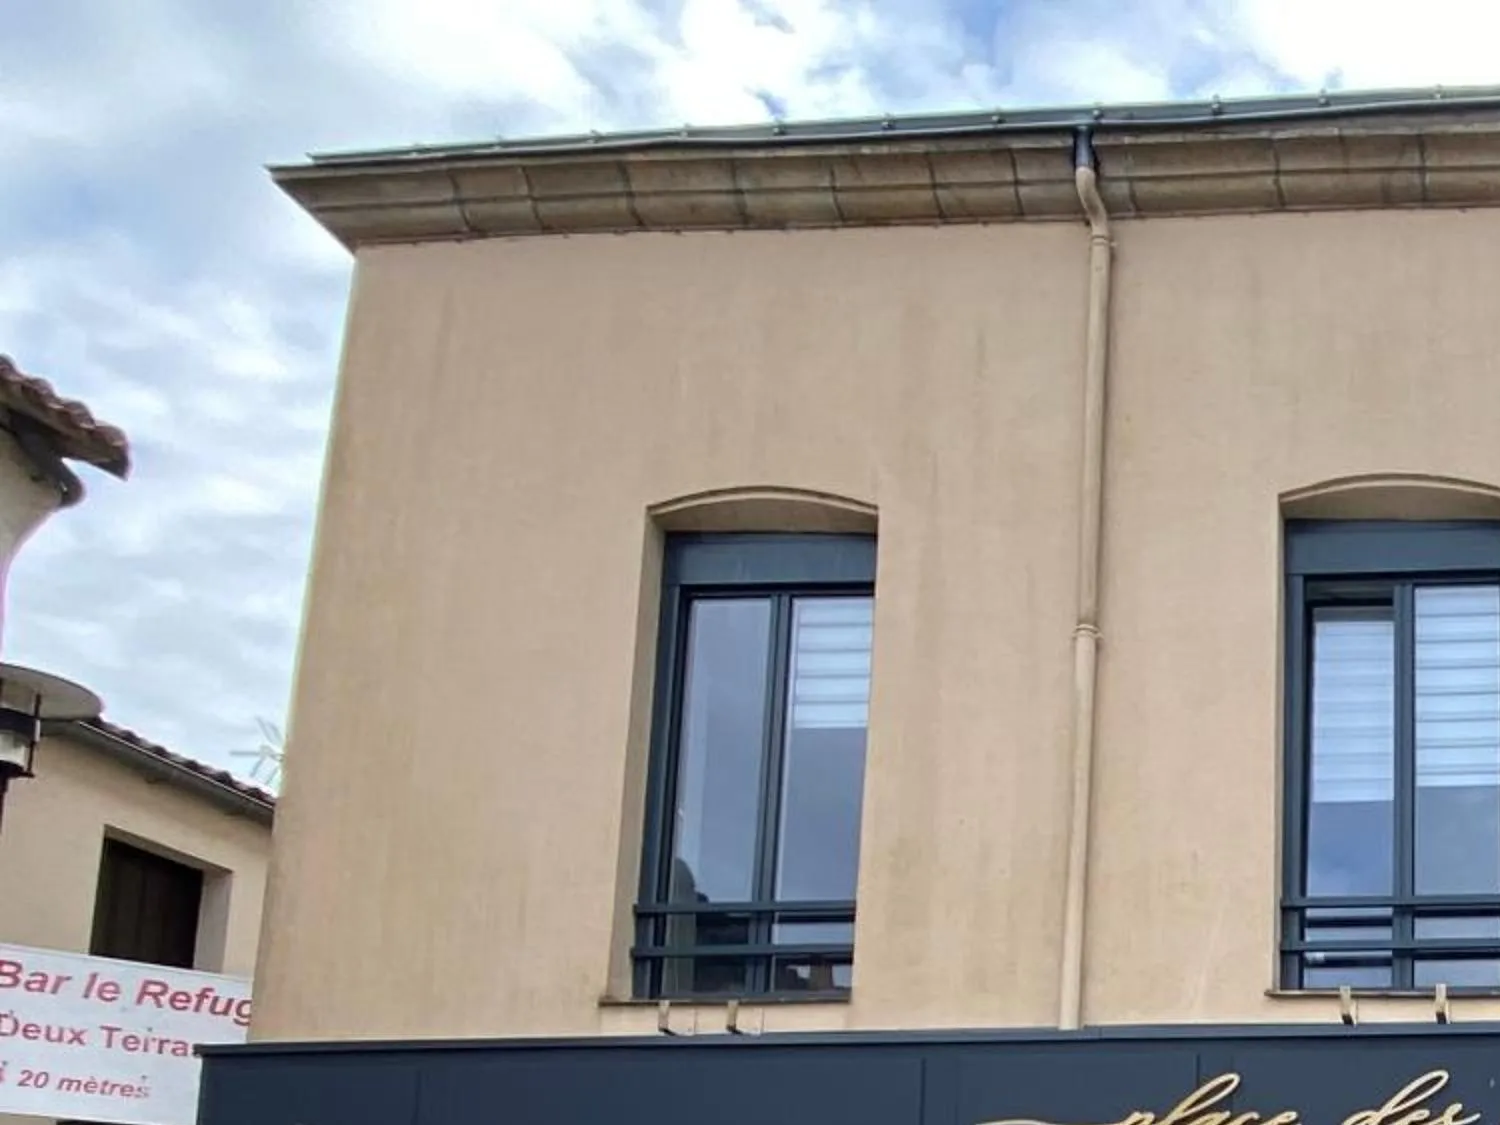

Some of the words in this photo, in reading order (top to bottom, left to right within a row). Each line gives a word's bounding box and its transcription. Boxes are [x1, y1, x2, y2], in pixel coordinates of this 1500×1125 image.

[0, 959, 71, 995] Bar
[82, 972, 121, 1002] le
[0, 1012, 88, 1046] Deux
[100, 1025, 201, 1058] Terra
[17, 1069, 49, 1088] 20
[56, 1076, 150, 1098] mètres
